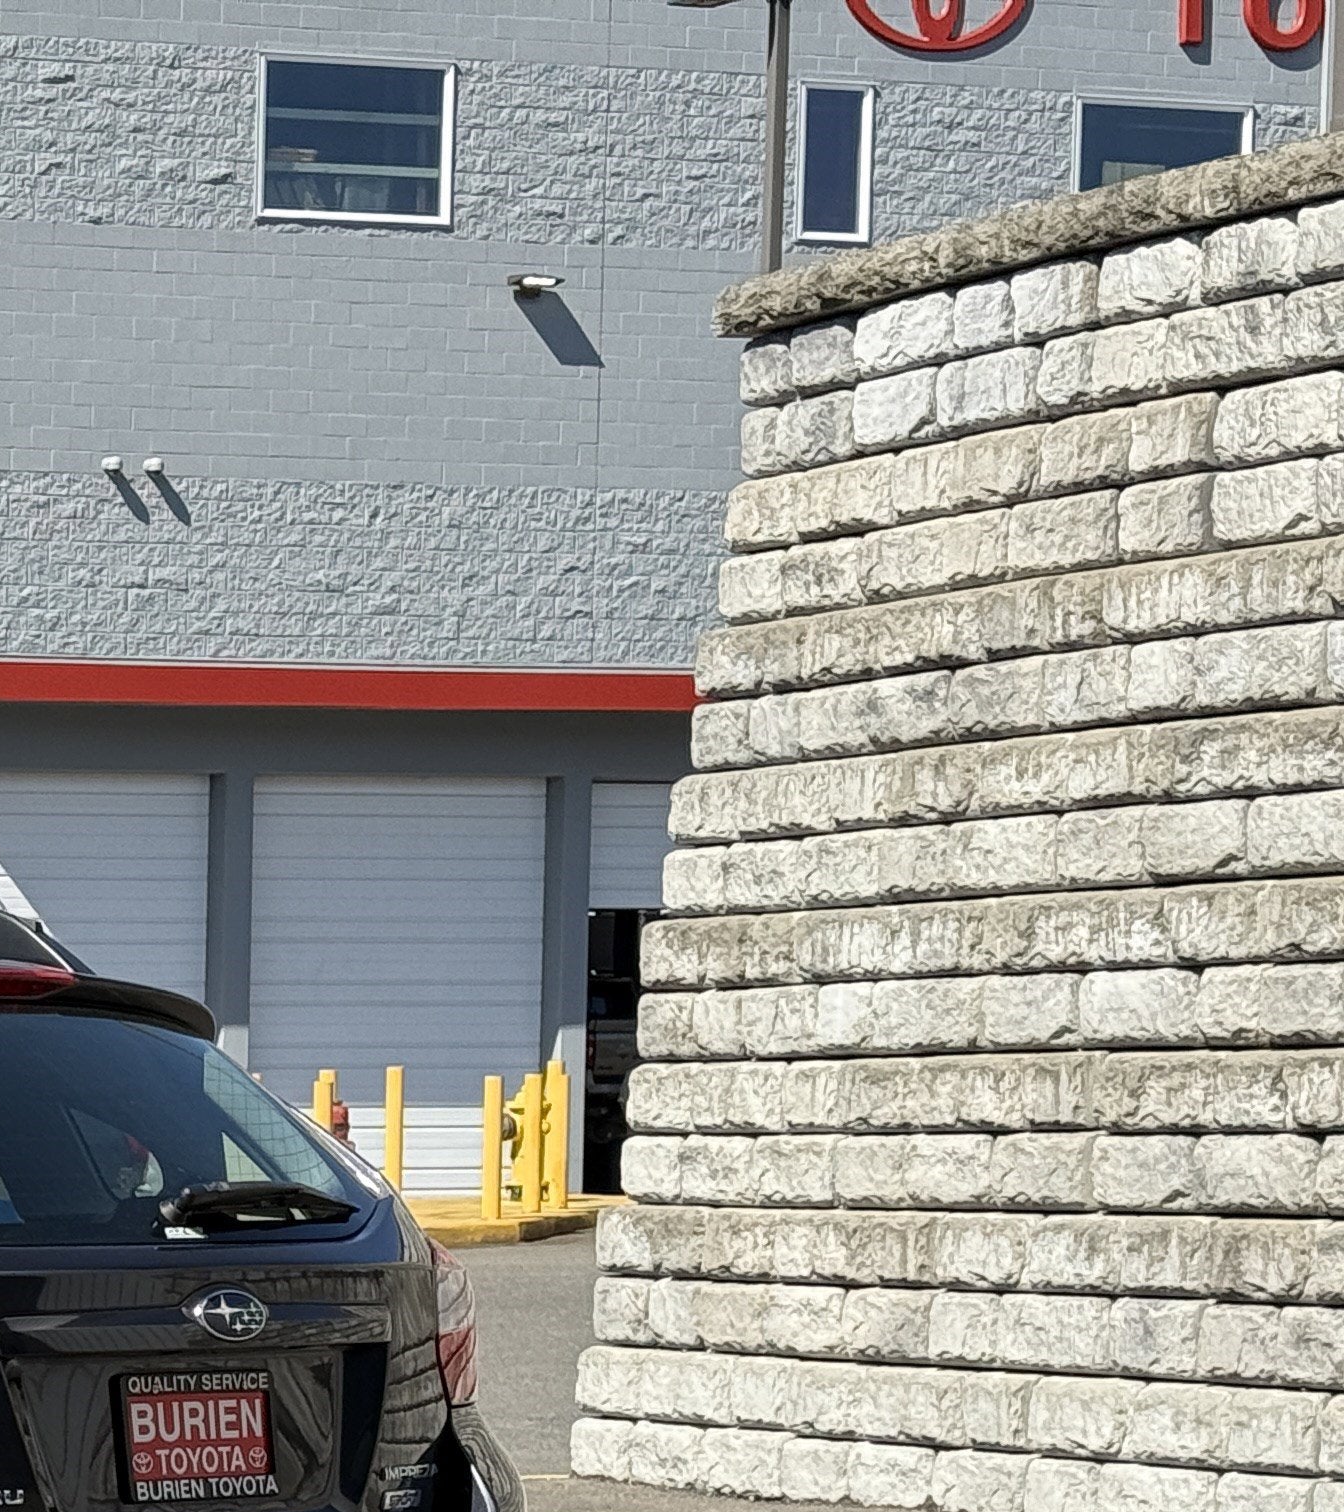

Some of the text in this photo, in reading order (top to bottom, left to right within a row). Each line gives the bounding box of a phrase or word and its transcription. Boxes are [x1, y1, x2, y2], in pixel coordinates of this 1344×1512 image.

[127, 1372, 269, 1394] QUALITY SERVICE
[130, 1398, 263, 1443] BURIEN
[155, 1445, 247, 1476] TOYOTA
[136, 1475, 279, 1501] BURIEN TOYOTA
